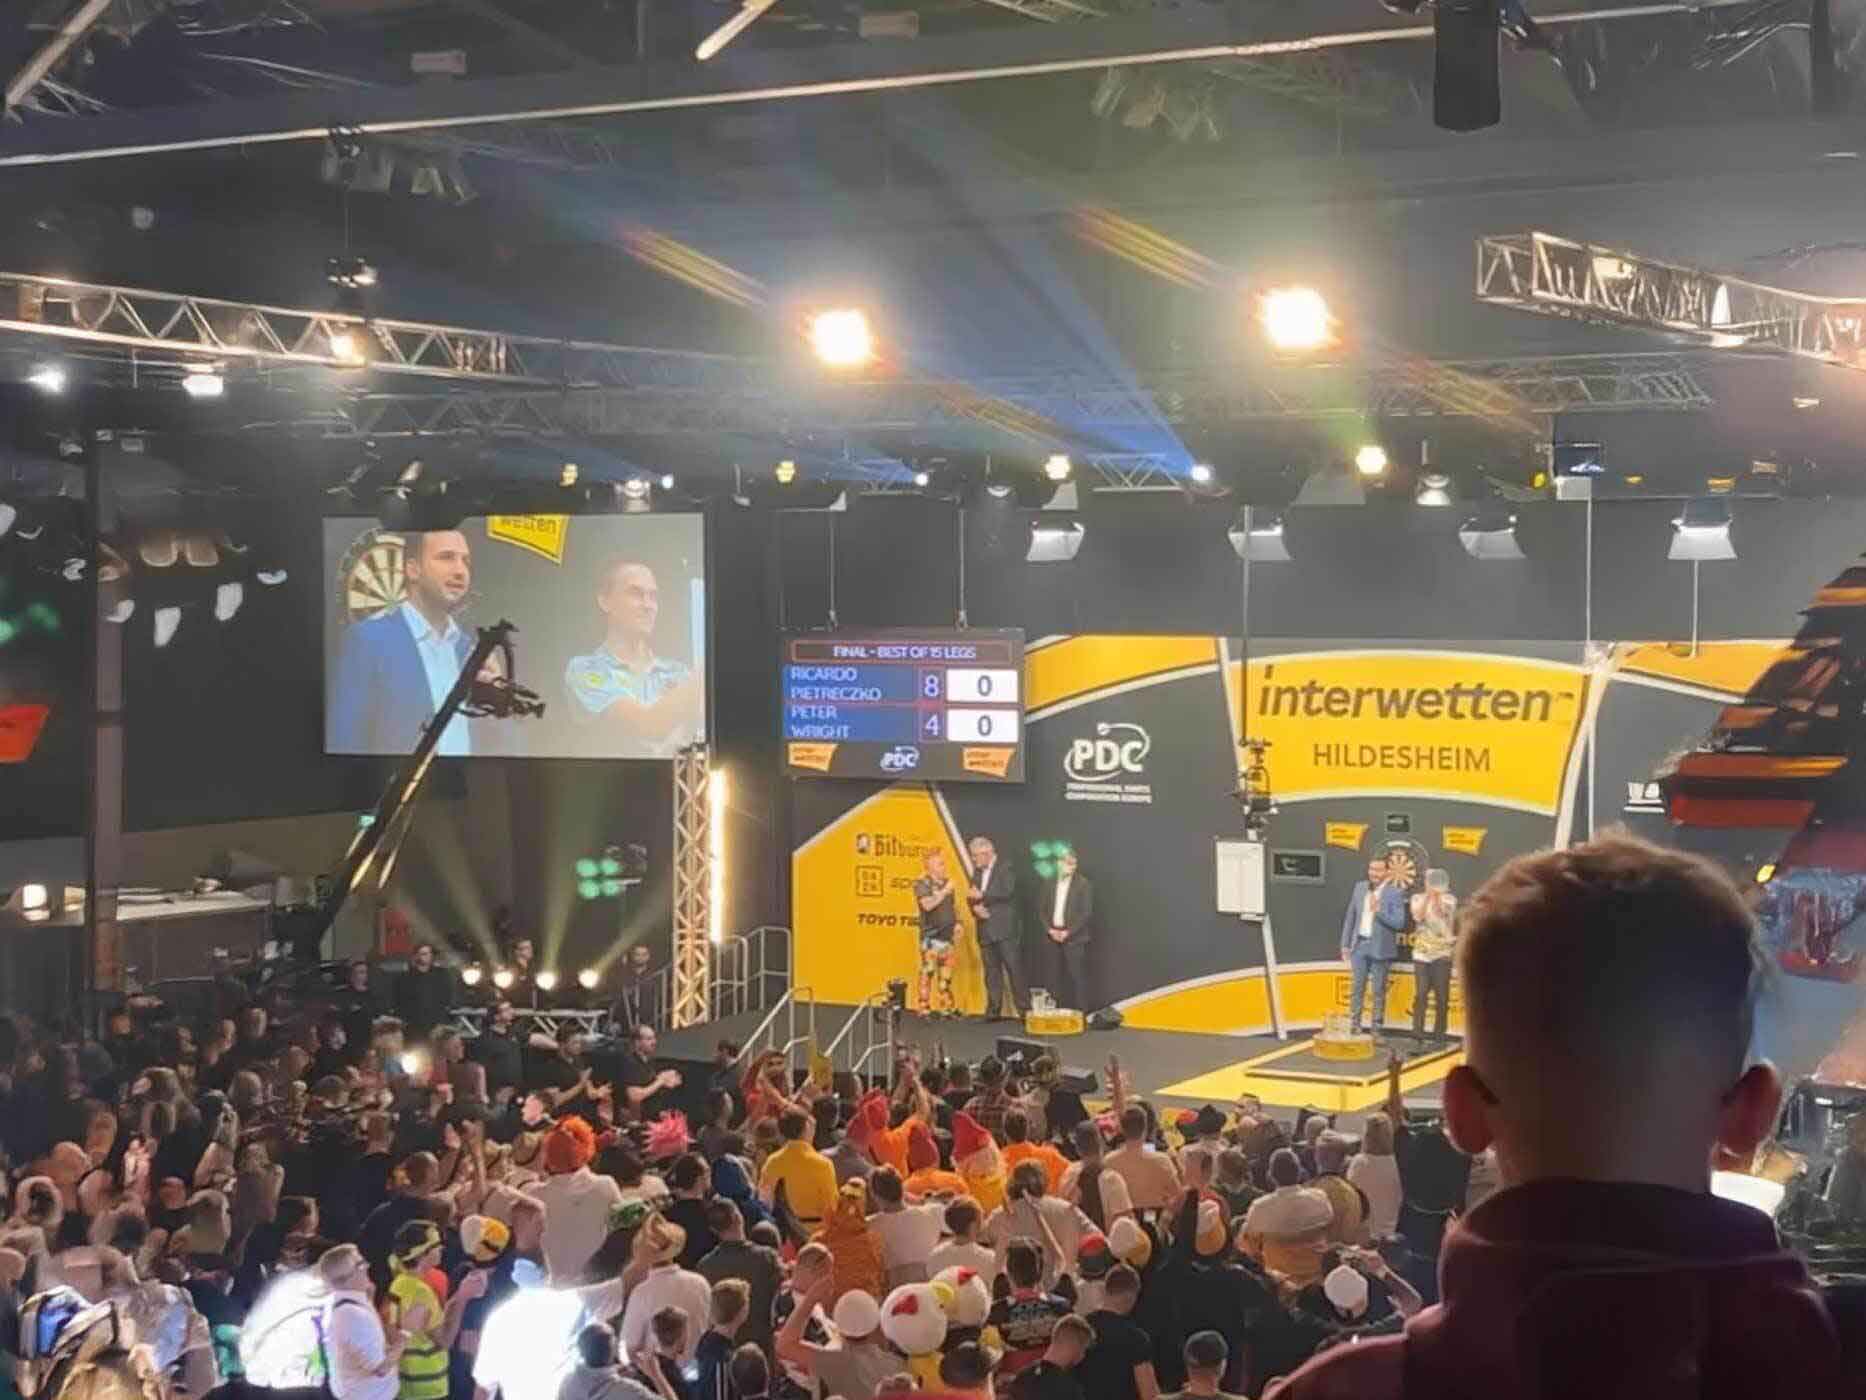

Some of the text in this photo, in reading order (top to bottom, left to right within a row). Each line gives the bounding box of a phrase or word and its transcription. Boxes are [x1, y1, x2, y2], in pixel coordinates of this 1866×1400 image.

[833, 646, 868, 658] FINAL
[877, 646, 907, 658] BEST
[910, 647, 928, 658] OF
[930, 647, 944, 658] 15
[945, 647, 977, 659] LEGS
[791, 667, 857, 681] RICARDO
[791, 686, 882, 701] PIETRECZKO
[924, 675, 940, 697] 8
[977, 675, 993, 697] 0
[1259, 664, 1552, 721] interwetten
[791, 705, 838, 719] PETER
[791, 725, 851, 738] WRIGHT
[924, 715, 940, 736] 4
[977, 715, 993, 736] 0
[1072, 738, 1144, 773] PDC
[1312, 743, 1491, 772] HILDESHEIM
[858, 912, 897, 927] TOYO
